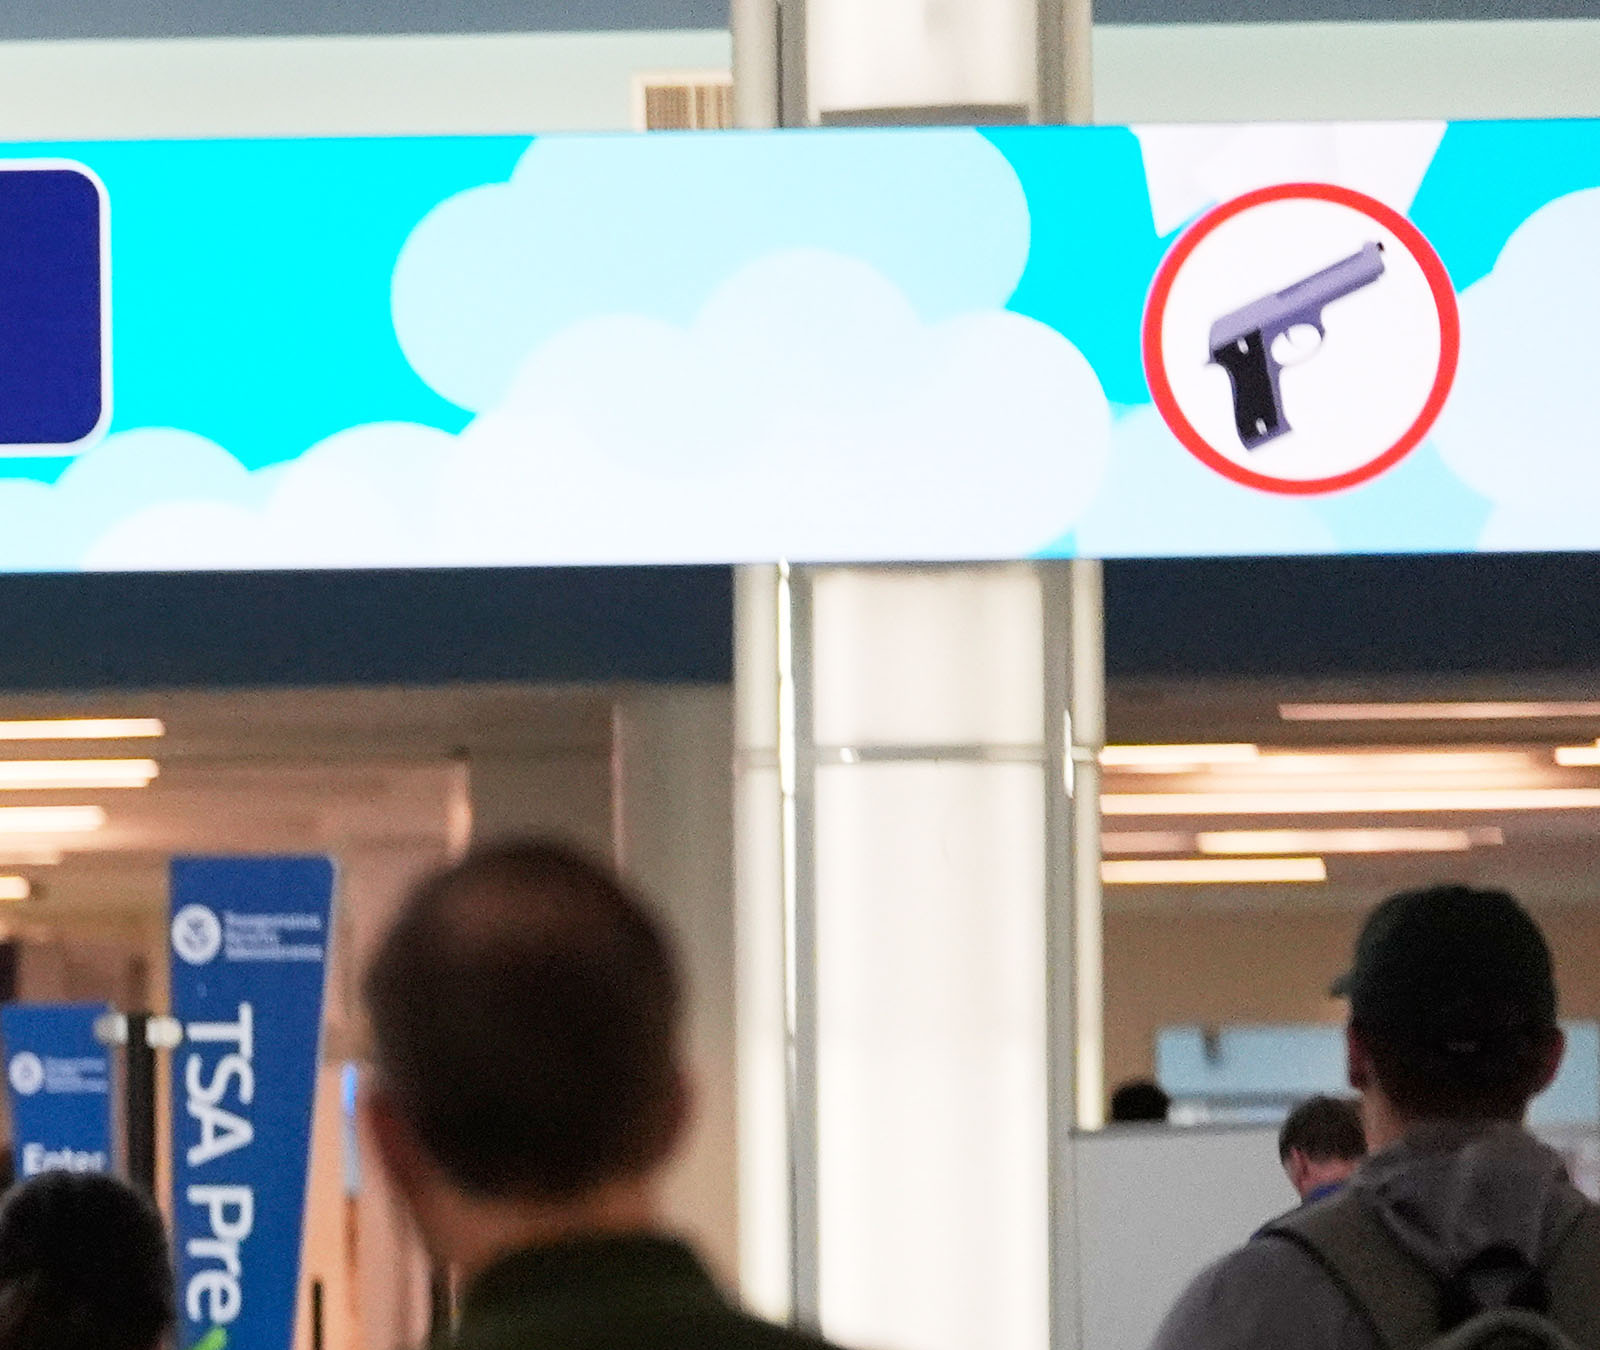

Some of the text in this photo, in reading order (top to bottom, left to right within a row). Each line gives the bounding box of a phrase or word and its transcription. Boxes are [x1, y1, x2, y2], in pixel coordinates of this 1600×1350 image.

[186, 1002, 254, 1166] TSA
[23, 1142, 105, 1177] Enter
[186, 1185, 254, 1324] Pre
